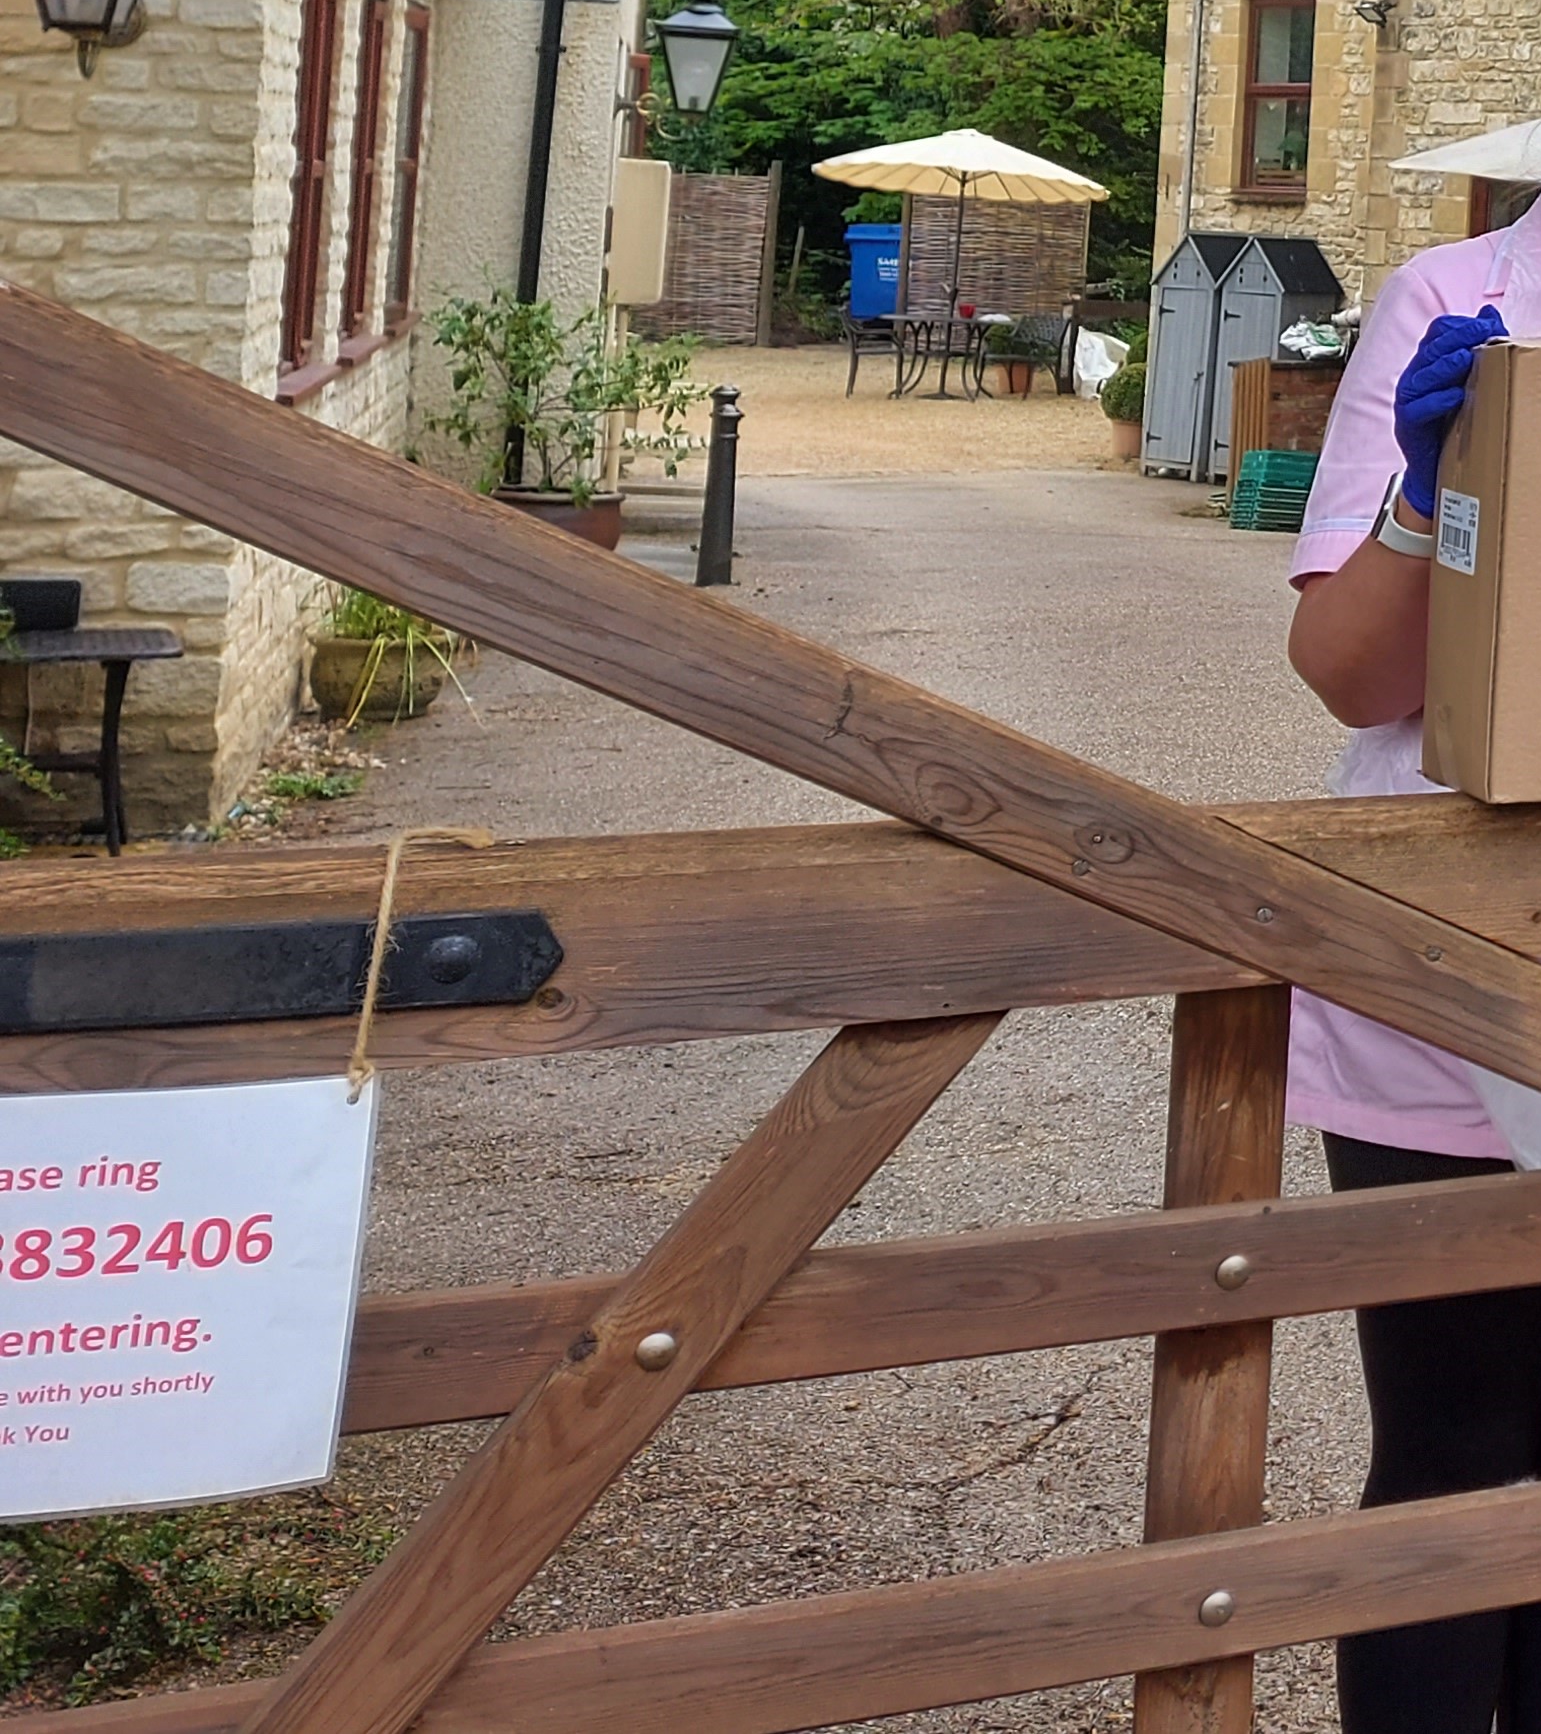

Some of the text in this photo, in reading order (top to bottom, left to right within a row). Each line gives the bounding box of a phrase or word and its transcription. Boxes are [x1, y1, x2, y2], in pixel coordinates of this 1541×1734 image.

[79, 1155, 162, 1192] ring
[0, 1214, 274, 1281] 832406
[0, 1314, 212, 1358] entering.
[17, 1383, 71, 1405] with
[80, 1383, 124, 1404] you
[130, 1371, 215, 1397] shortly
[25, 1424, 70, 1444] You
